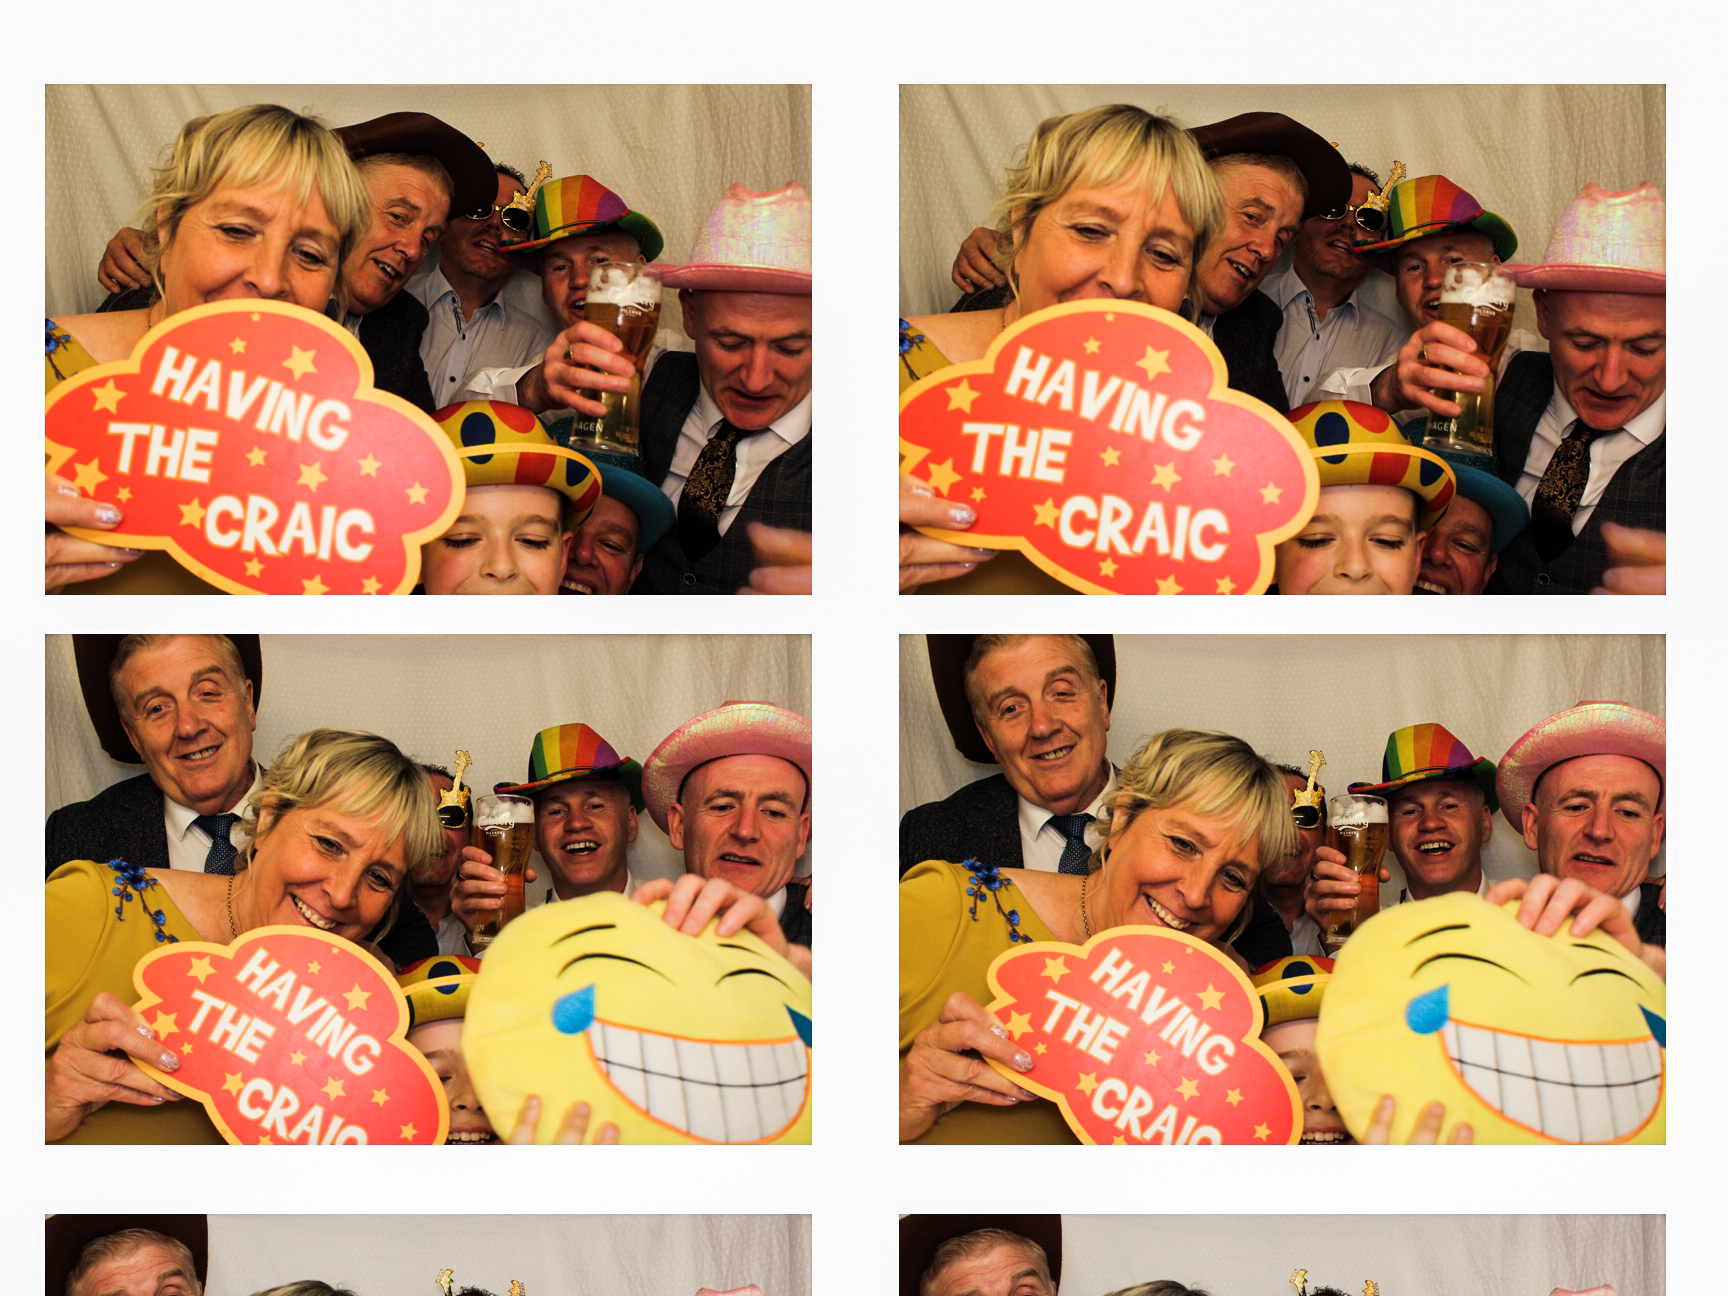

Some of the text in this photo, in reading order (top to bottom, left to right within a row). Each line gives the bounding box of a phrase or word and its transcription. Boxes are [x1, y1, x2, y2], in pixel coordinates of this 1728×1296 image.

[151, 345, 352, 451] HAVING
[576, 421, 604, 432] AGEN
[1005, 345, 1206, 451] HAVING
[1430, 421, 1458, 432] AGEN
[107, 422, 219, 484] THE
[961, 422, 1073, 484] THE
[204, 494, 375, 562] CRAIC
[1058, 494, 1229, 562] CRAIC
[188, 988, 276, 1065] THE
[235, 947, 382, 1075] HAVING
[1042, 988, 1130, 1065] THE
[1089, 947, 1236, 1075] HAVING
